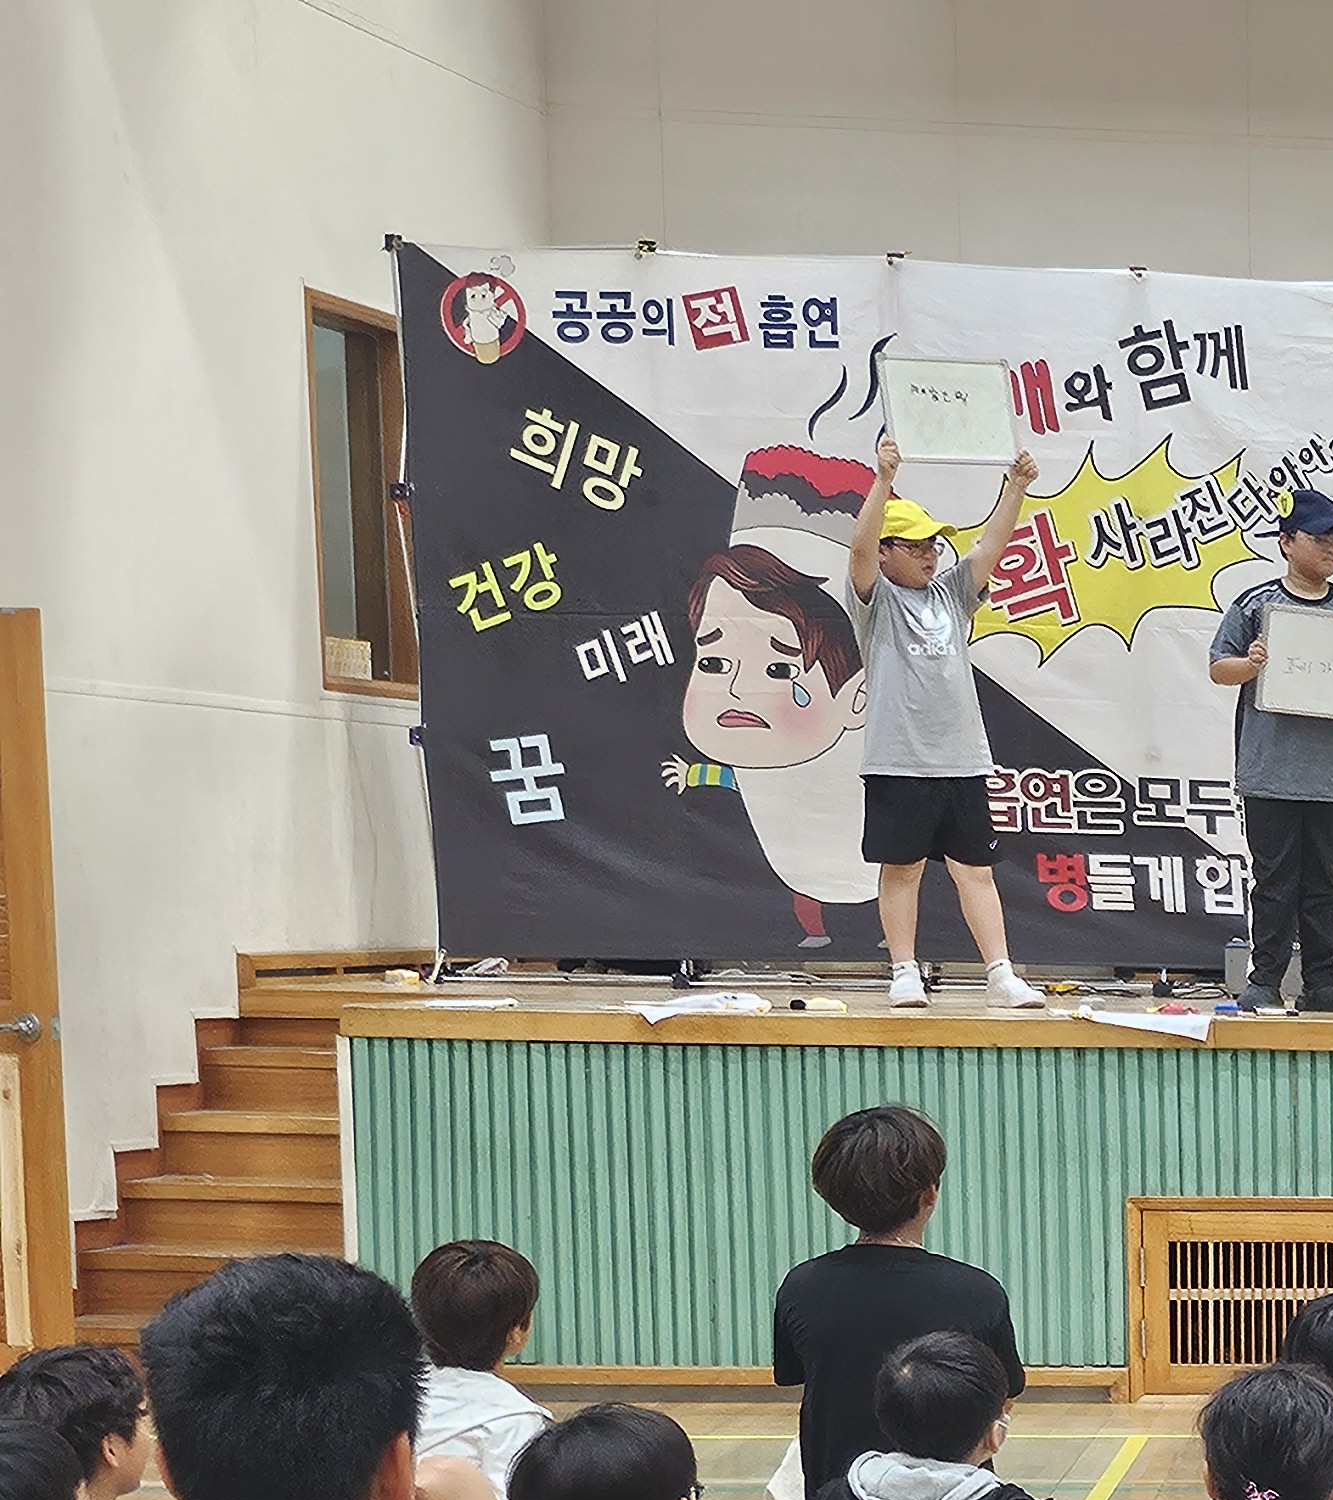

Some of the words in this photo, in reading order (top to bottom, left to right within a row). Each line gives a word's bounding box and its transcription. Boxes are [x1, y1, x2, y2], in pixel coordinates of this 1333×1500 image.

[552, 290, 675, 346] 공공의
[690, 290, 746, 347] 적
[758, 294, 840, 349] 흡연
[1009, 358, 1113, 437] 배와
[1119, 320, 1249, 411] 함께
[510, 407, 643, 511] 희망
[449, 542, 563, 632] 건강
[575, 611, 674, 683] 미래
[490, 734, 566, 826] 꿈
[1134, 776, 1244, 836] 모두
[1037, 852, 1185, 913] 병들게
